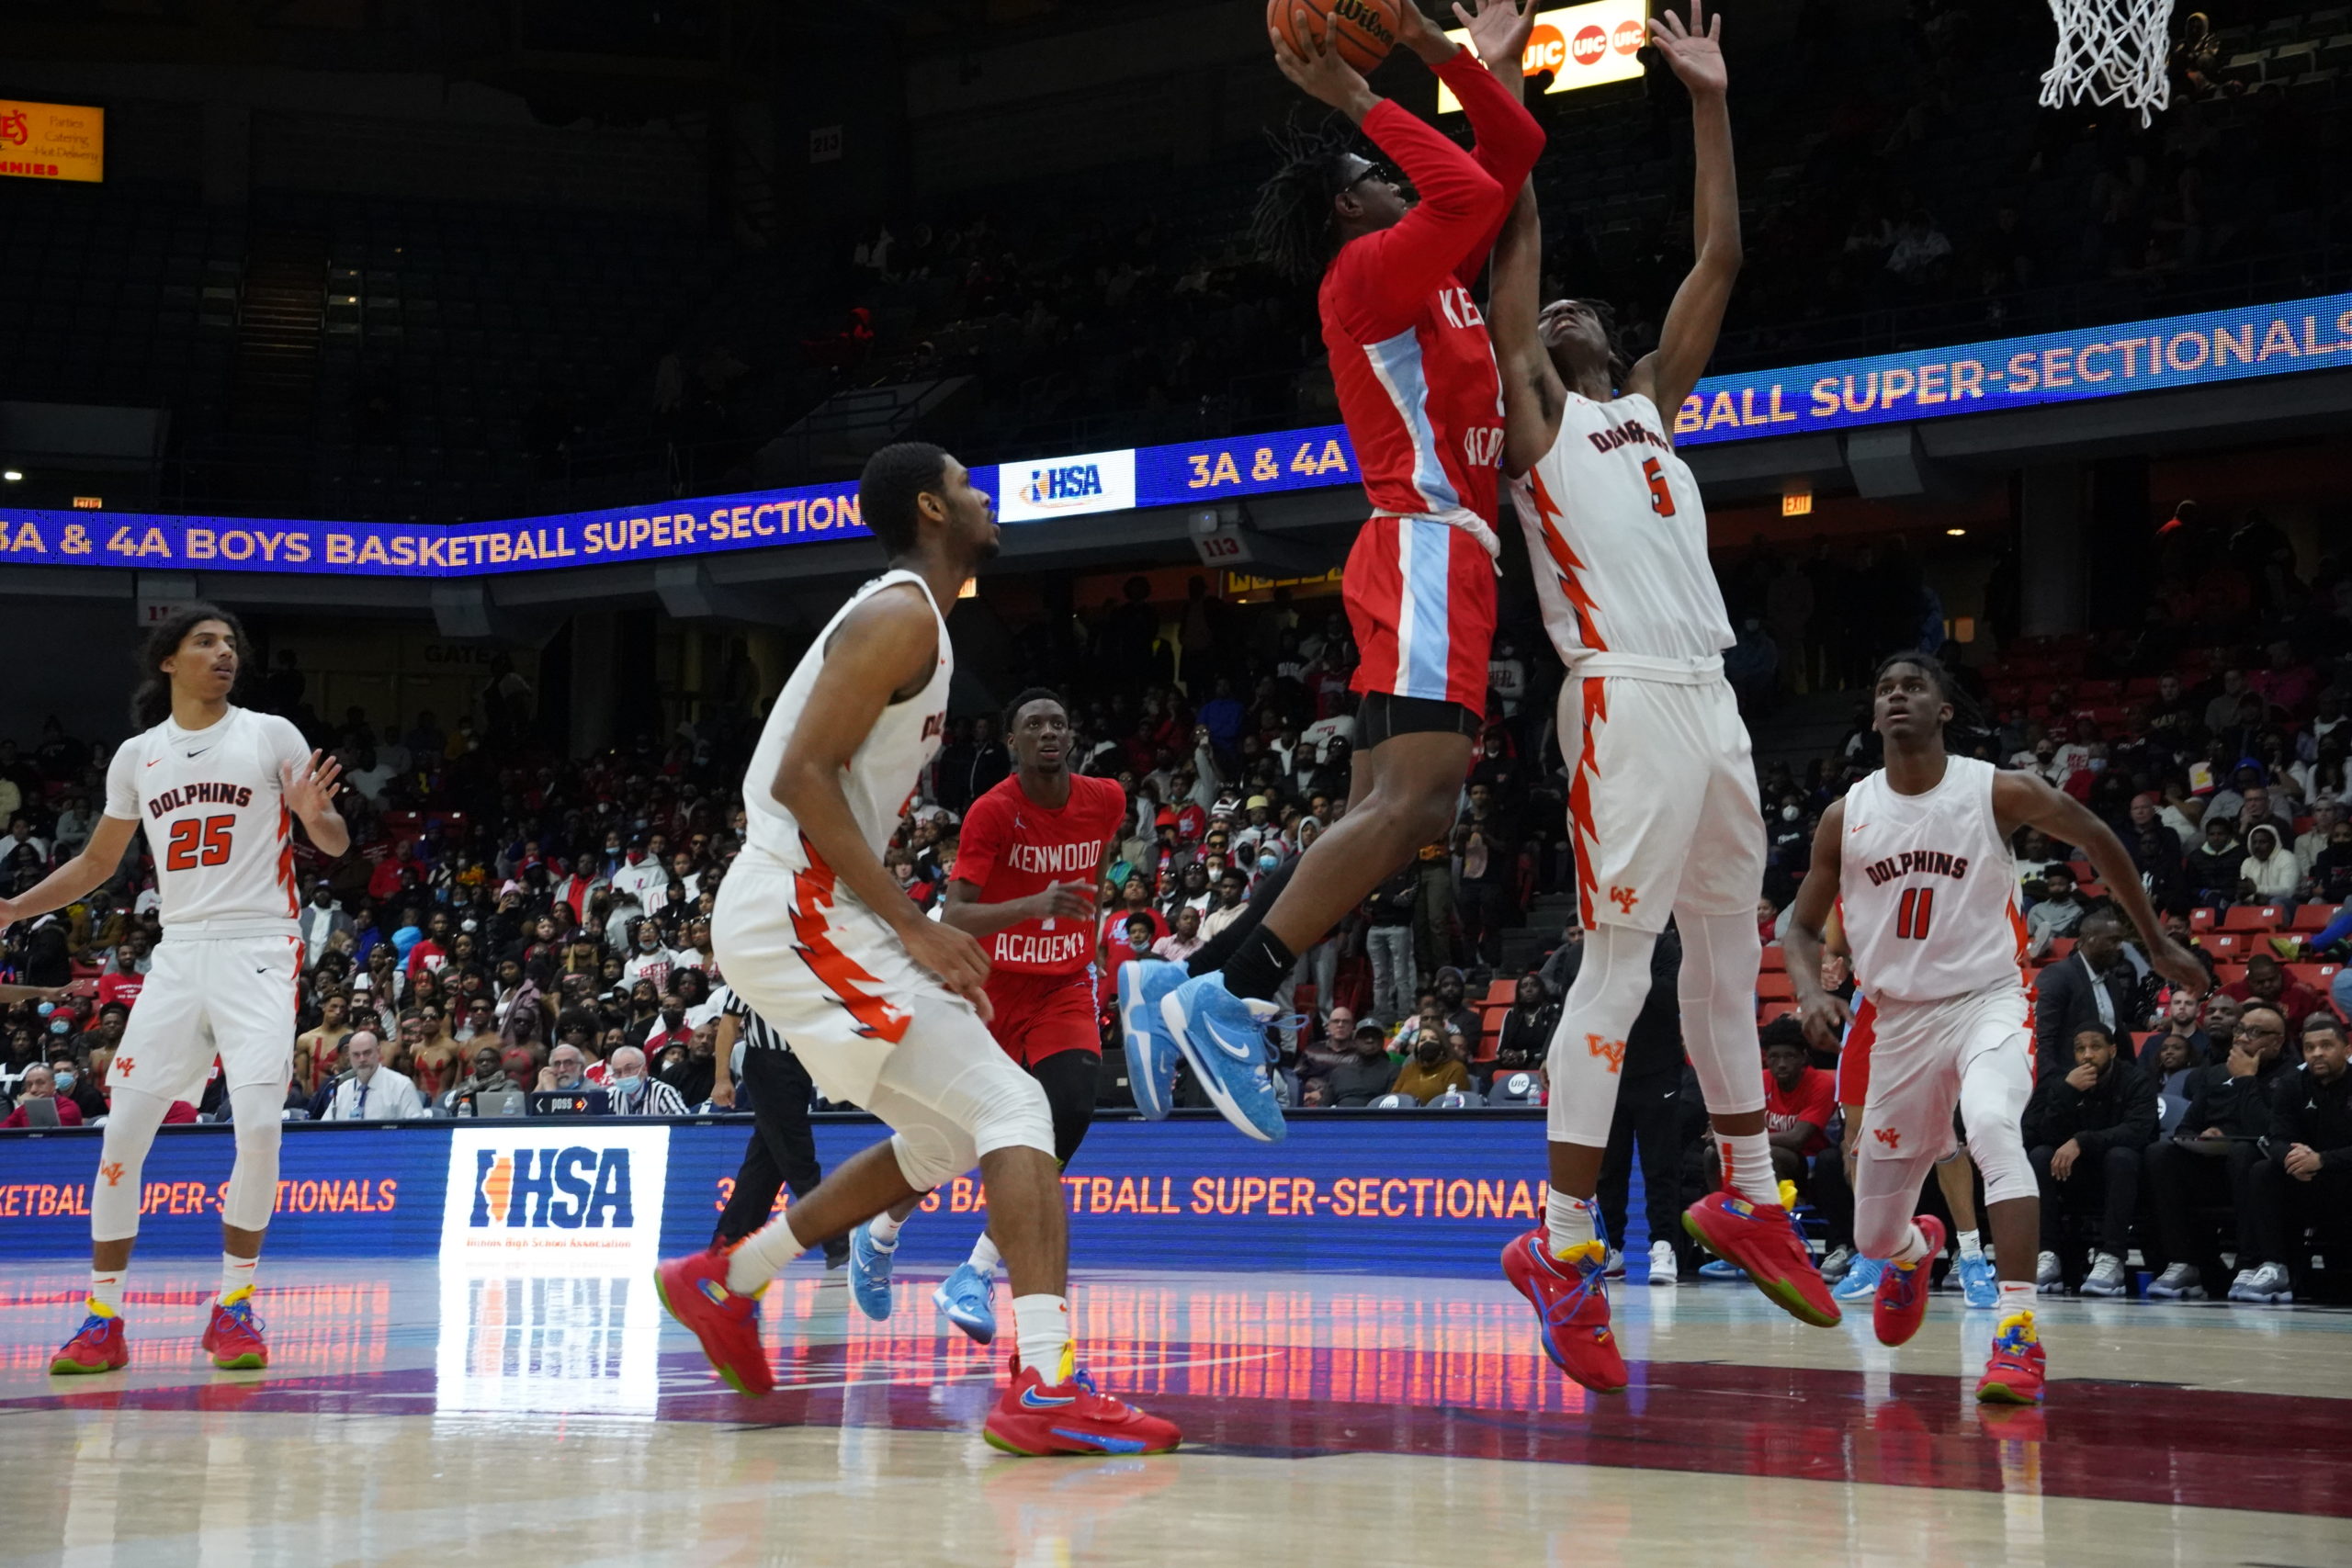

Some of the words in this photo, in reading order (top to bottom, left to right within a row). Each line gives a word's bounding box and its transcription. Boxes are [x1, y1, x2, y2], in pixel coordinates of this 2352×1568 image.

[1573, 35, 1606, 56] UIC
[1613, 29, 1644, 48] UIC
[44, 131, 89, 148] Catering
[50, 116, 84, 129] Parties
[1439, 287, 1486, 329] KE
[1809, 310, 2352, 418] SUPER-SECTIONALS
[1188, 452, 1242, 489] 3A
[1251, 447, 1280, 481] &
[1291, 439, 1349, 477] 4A
[1642, 457, 1676, 518] 5
[1785, 494, 1809, 513] EXIT
[61, 524, 93, 554] &
[107, 526, 172, 558] 4A
[187, 528, 311, 562] BOYS
[325, 526, 576, 567] BASKETBALL
[583, 493, 867, 554] SUPER-SECTION
[1204, 537, 1239, 558] 113
[148, 783, 253, 819] DOLPHINS
[166, 814, 236, 872] 25
[1008, 839, 1102, 874] KENWOOD
[1865, 851, 1968, 887] DOLPHINS
[1896, 887, 1934, 940] 11
[994, 931, 1085, 964] ACADEMY
[469, 1146, 635, 1228] IHSA
[505, 1236, 528, 1250] High
[531, 1236, 566, 1247] School
[570, 1236, 631, 1247] Association
